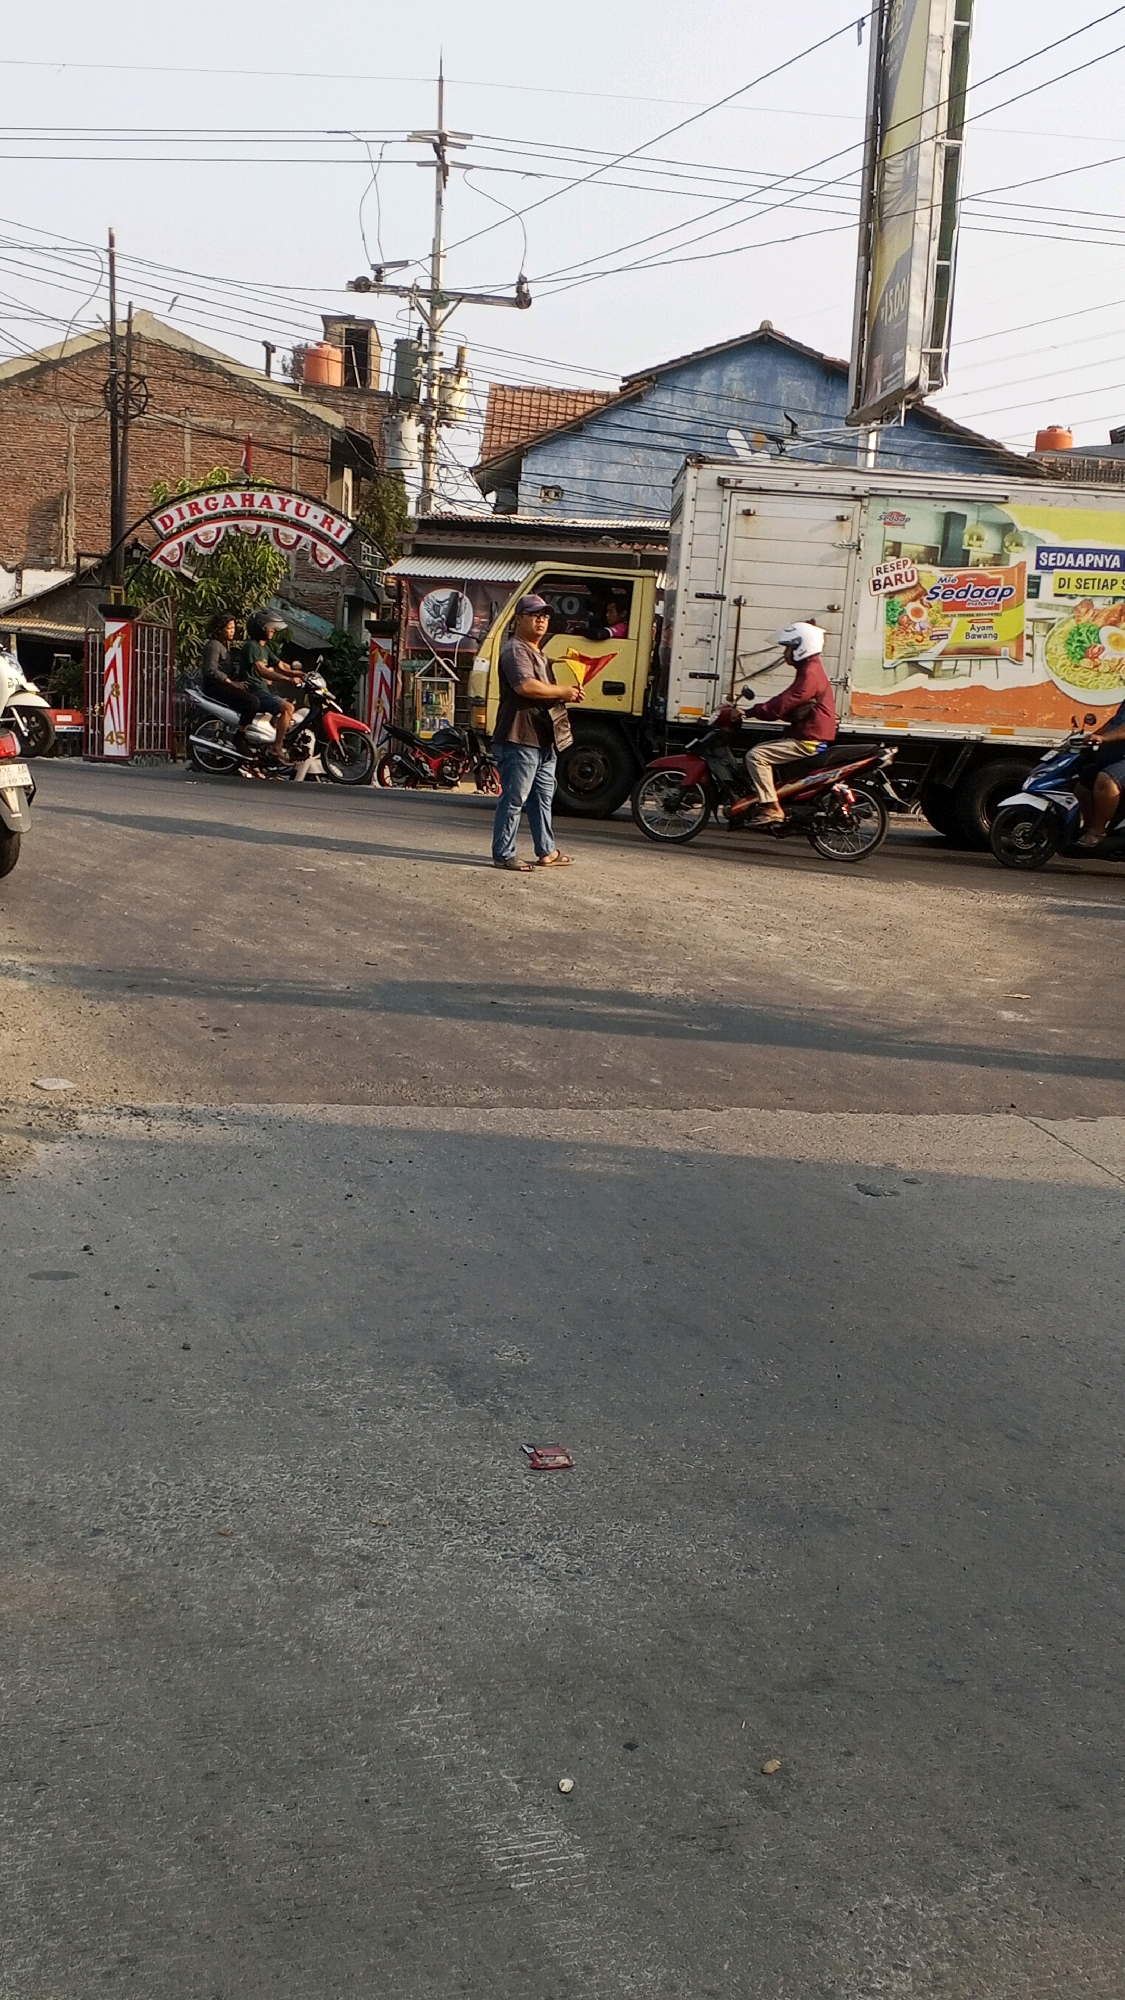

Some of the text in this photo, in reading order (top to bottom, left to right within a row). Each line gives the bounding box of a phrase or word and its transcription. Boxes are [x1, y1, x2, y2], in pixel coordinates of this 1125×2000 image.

[876, 559, 909, 576] RESEP
[1039, 552, 1121, 569] SEDAAPNYA
[872, 570, 915, 592] BARU
[937, 576, 957, 584] Mie
[1058, 577, 1071, 590] DI
[1075, 577, 1118, 591] SETIAP
[926, 583, 1014, 602] Sedaap
[970, 624, 994, 632] Ayam
[109, 633, 126, 648] 17
[965, 632, 998, 640] Bawang
[111, 683, 121, 698] 8
[105, 731, 126, 745] 45
